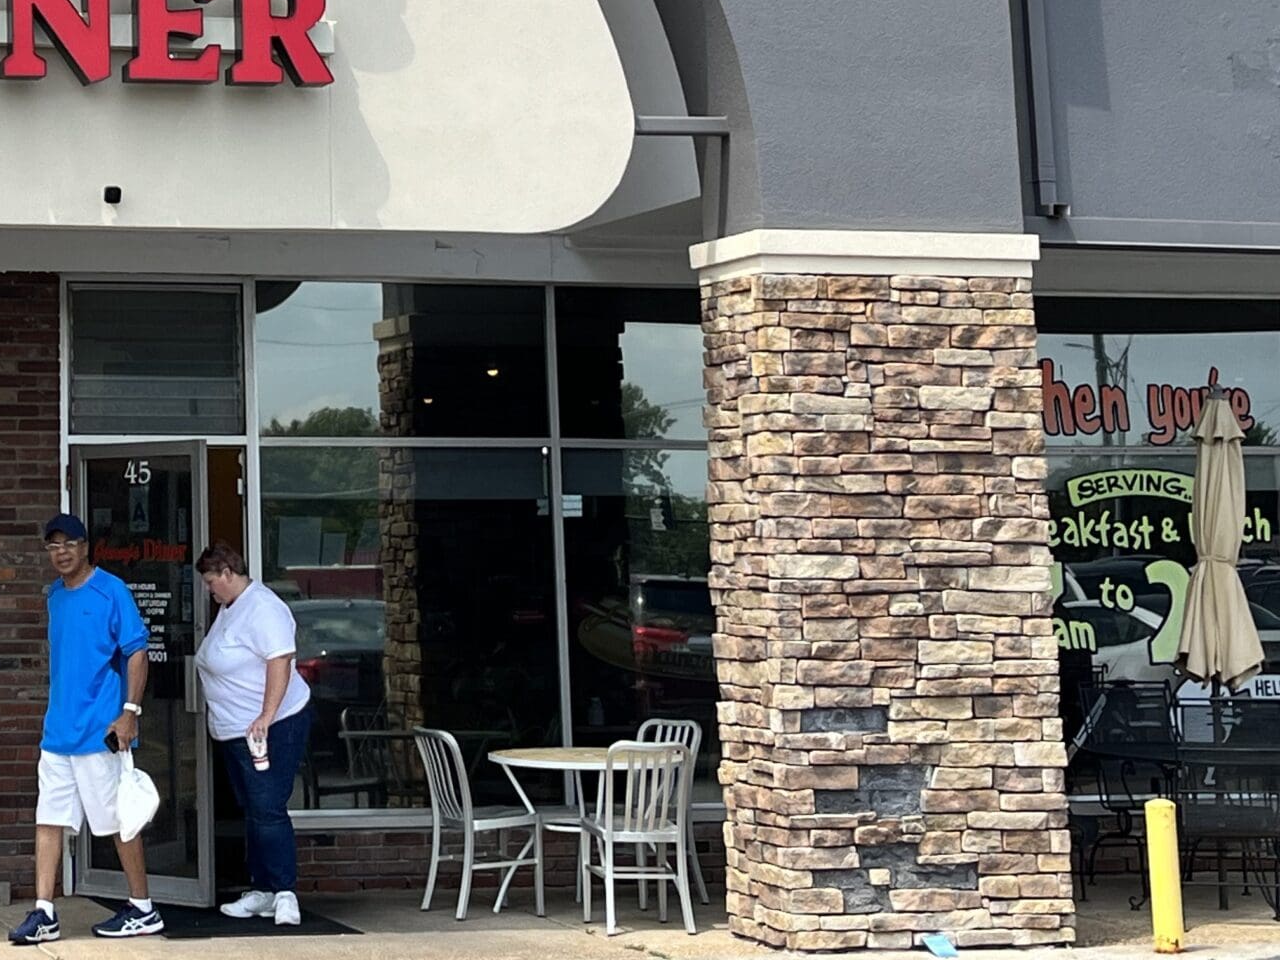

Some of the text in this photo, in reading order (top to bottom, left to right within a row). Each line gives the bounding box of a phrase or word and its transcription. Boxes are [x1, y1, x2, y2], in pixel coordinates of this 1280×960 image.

[1039, 358, 1255, 446] hen you'e
[124, 460, 151, 484] 45
[1047, 511, 1154, 550] eakfast
[1162, 517, 1181, 543] &
[1099, 577, 1134, 611] to
[1053, 617, 1096, 652] am
[1255, 679, 1280, 696] HEL
